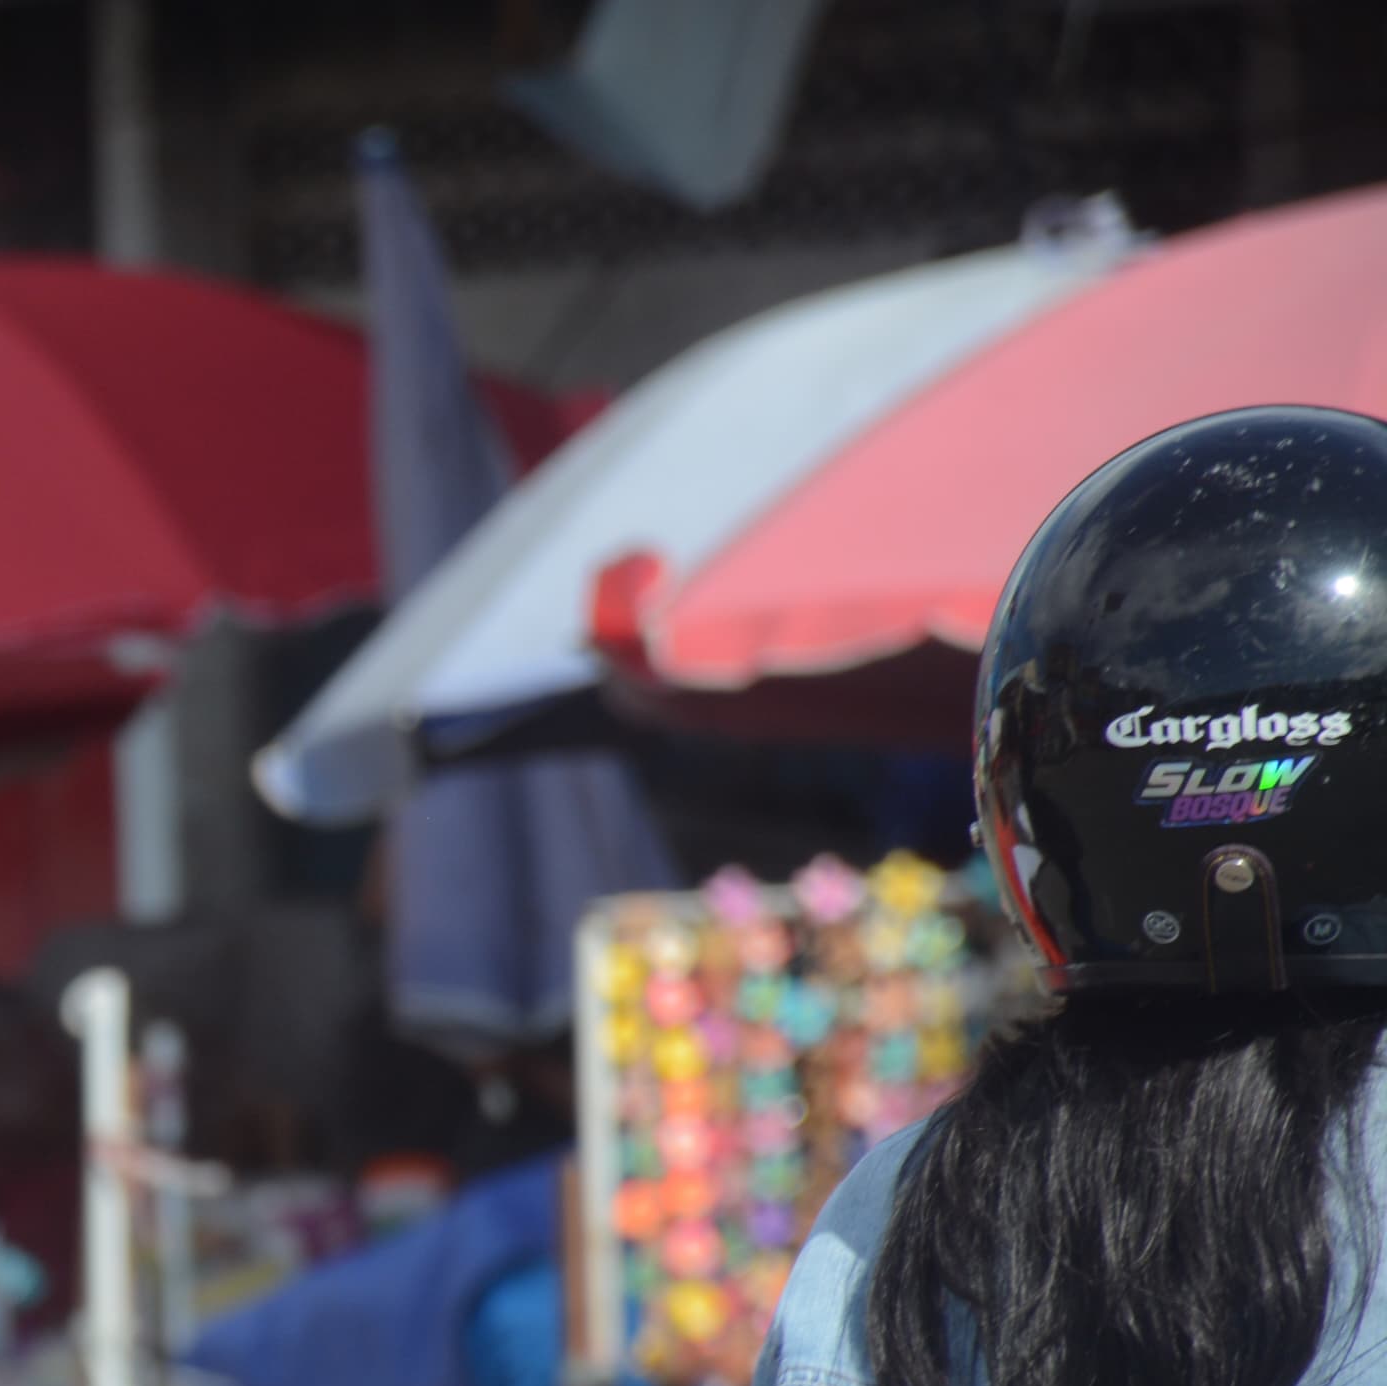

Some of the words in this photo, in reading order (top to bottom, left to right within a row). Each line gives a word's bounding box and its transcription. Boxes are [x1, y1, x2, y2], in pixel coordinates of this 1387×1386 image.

[1105, 703, 1354, 751] Cargloss
[1140, 755, 1315, 799] SLOW
[1169, 786, 1293, 823] BOSQUE
